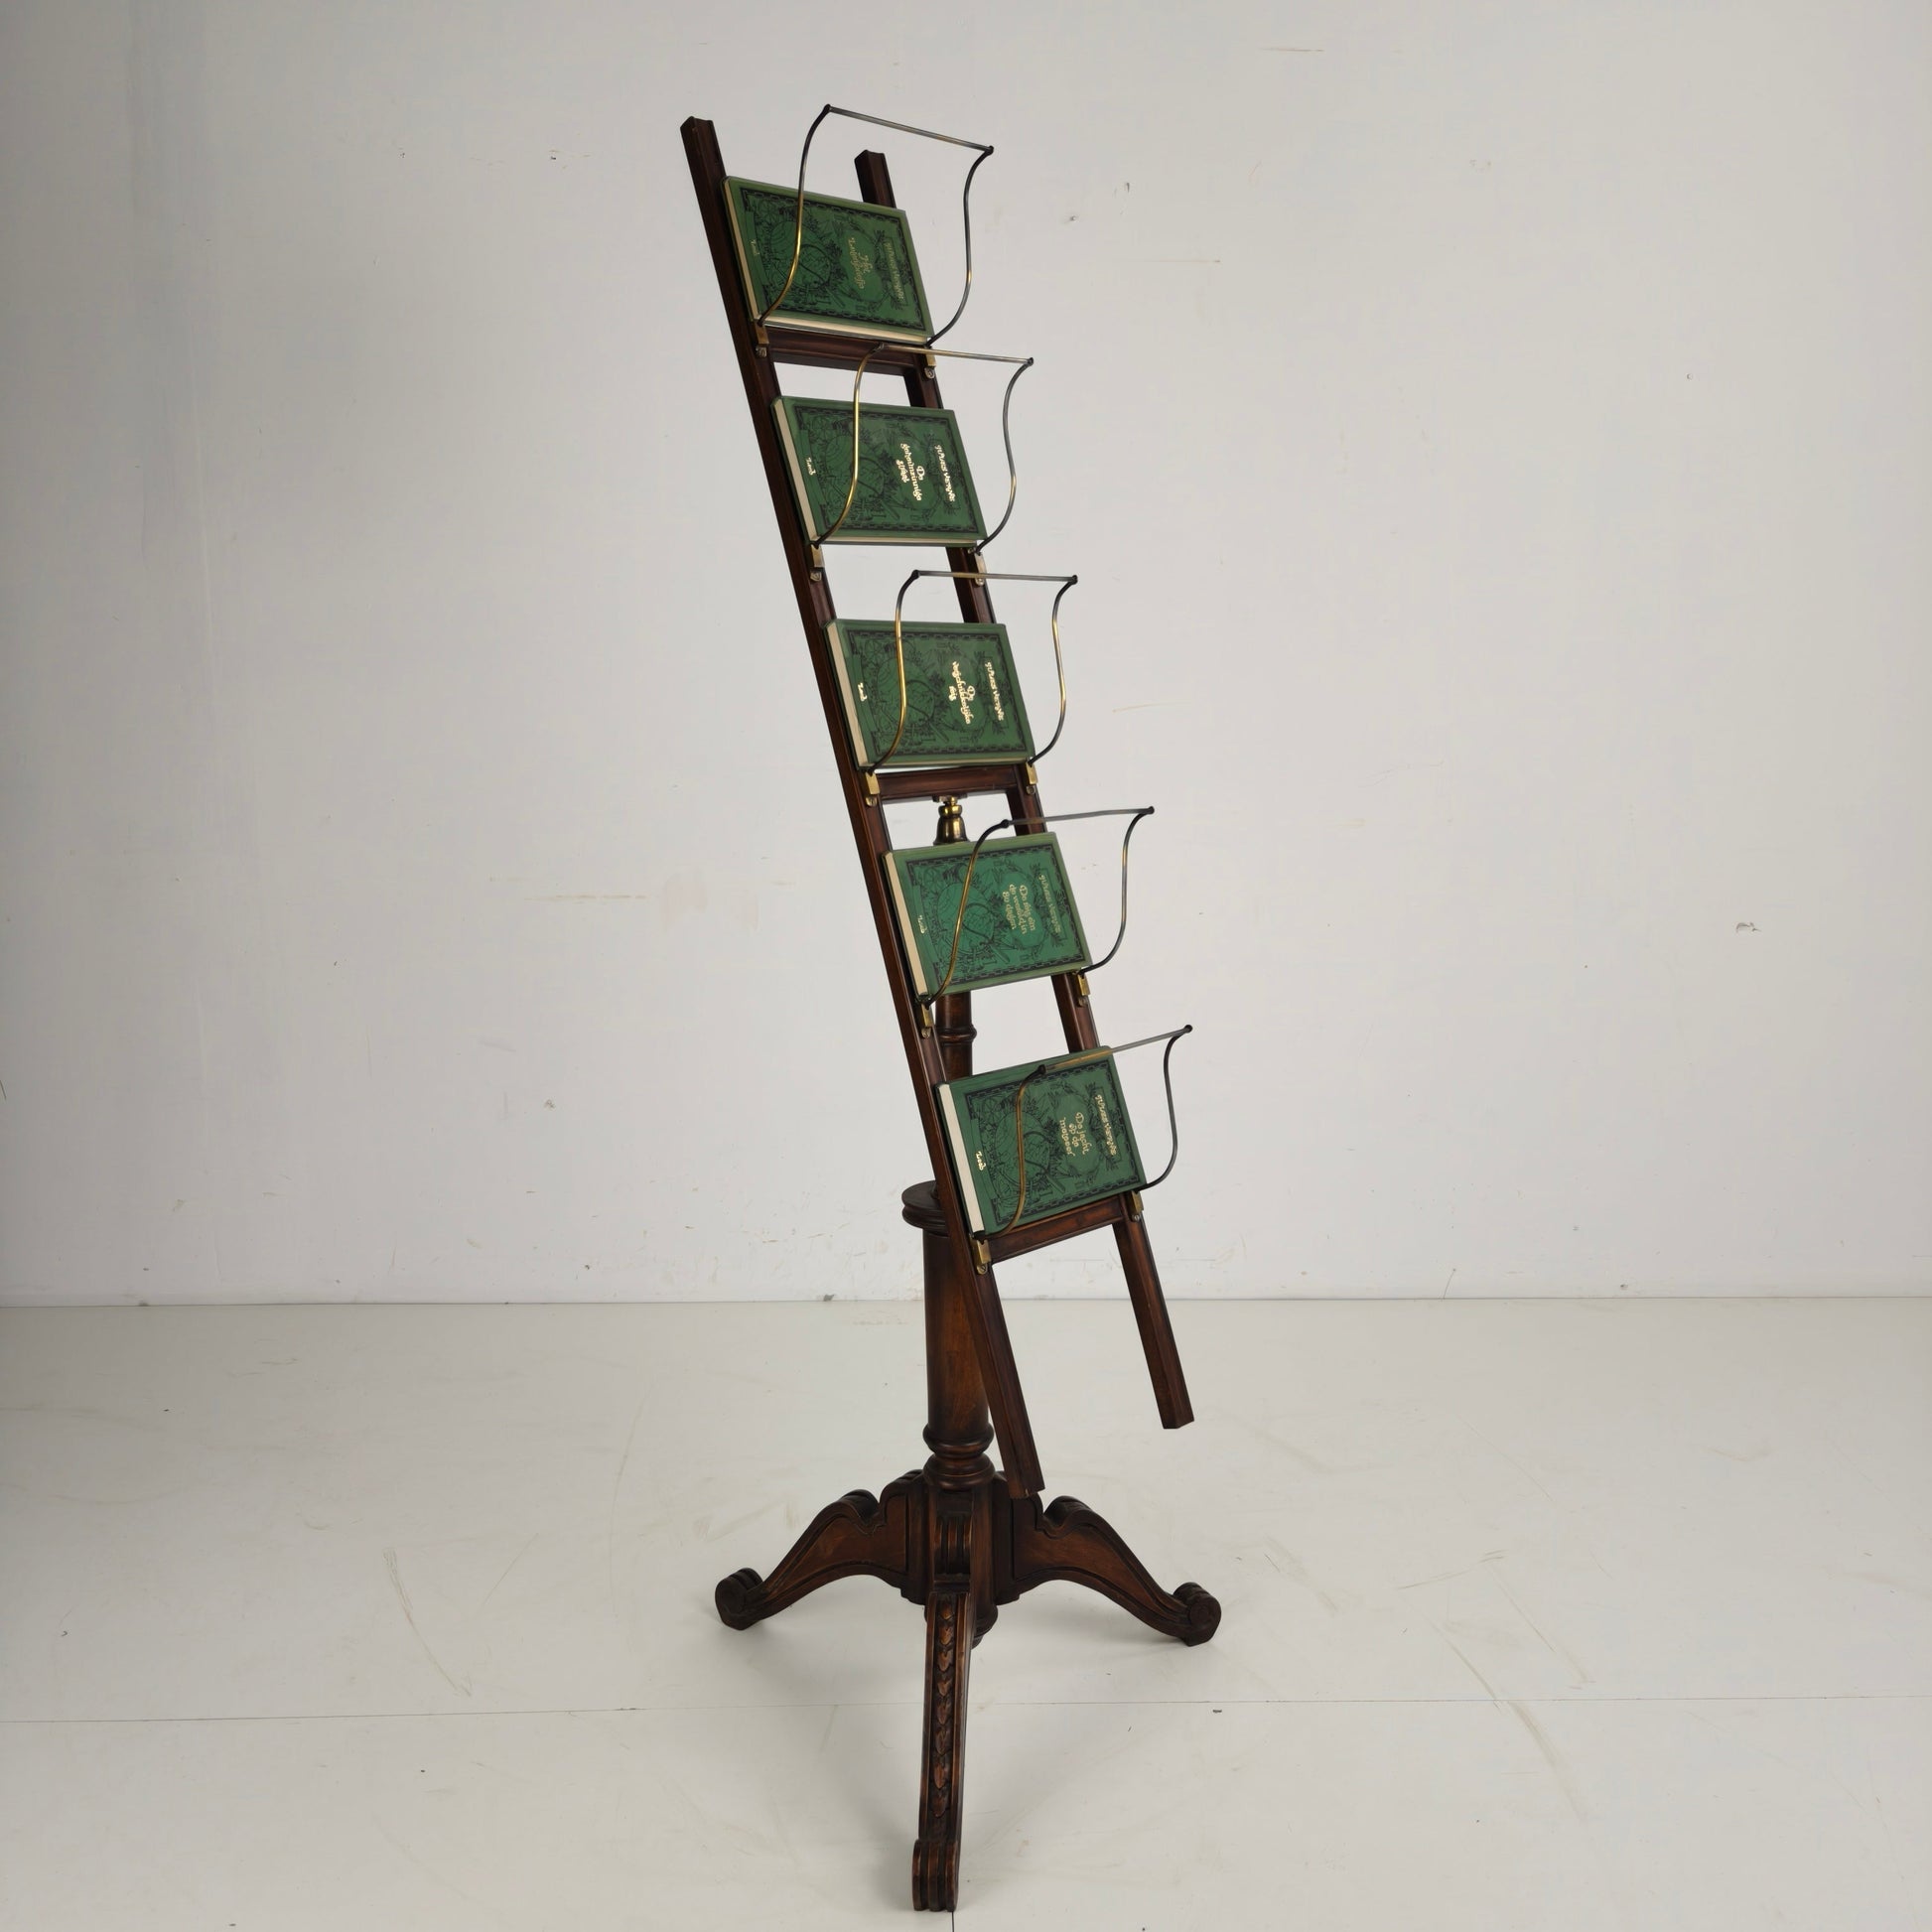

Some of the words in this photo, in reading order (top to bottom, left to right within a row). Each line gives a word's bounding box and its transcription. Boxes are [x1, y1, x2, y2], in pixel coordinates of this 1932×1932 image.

[900, 444, 922, 500] geheimzinnige
[916, 466, 924, 480] De
[966, 686, 975, 701] De
[1003, 890, 1010, 902] 80
[1019, 885, 1028, 900] De
[1006, 903, 1017, 929] dagen
[1009, 885, 1017, 895] de
[1014, 896, 1027, 925] wereld
[1021, 924, 1028, 934] in
[1023, 902, 1032, 917] reis
[1026, 915, 1035, 930] om
[1075, 1112, 1084, 1129] De
[1059, 1117, 1075, 1156] meteoor
[1068, 1124, 1078, 1134] op
[1072, 1137, 1080, 1147] de
[1076, 1131, 1092, 1155] jacht
